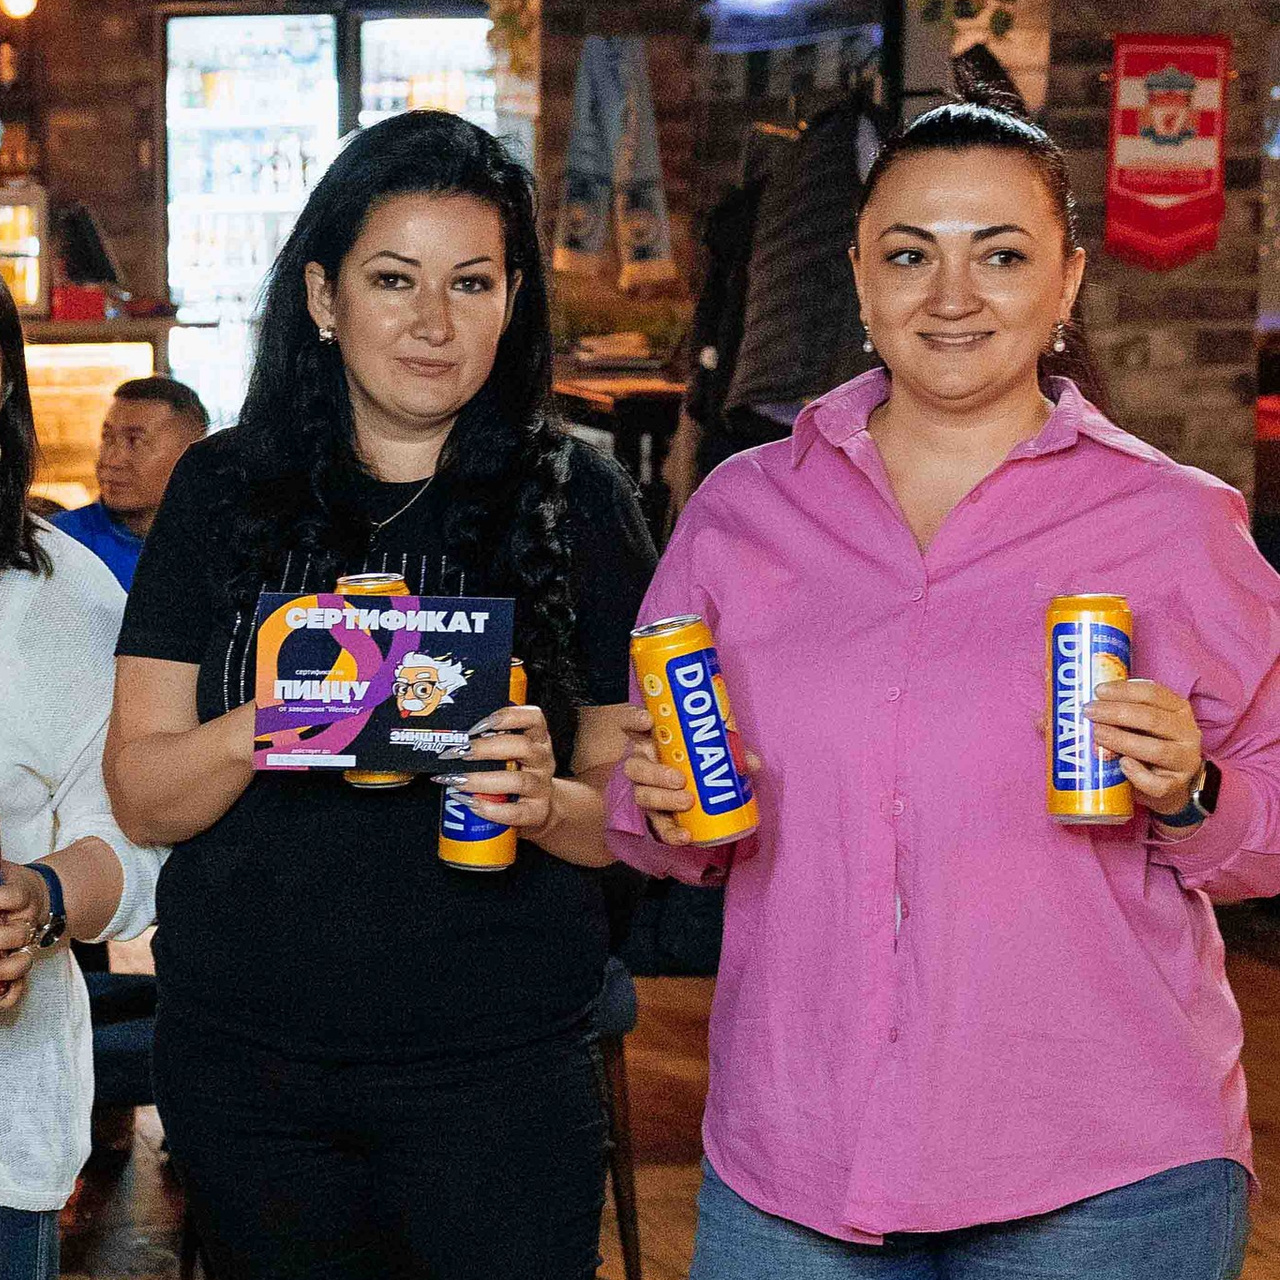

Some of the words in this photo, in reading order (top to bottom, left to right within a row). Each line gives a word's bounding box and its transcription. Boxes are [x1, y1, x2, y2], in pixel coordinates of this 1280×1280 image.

[285, 607, 489, 634] СЕРТИФИКАТ
[274, 679, 371, 704] ПИЦЦУ
[412, 739, 447, 754] Party
[674, 662, 737, 805] DONAVI
